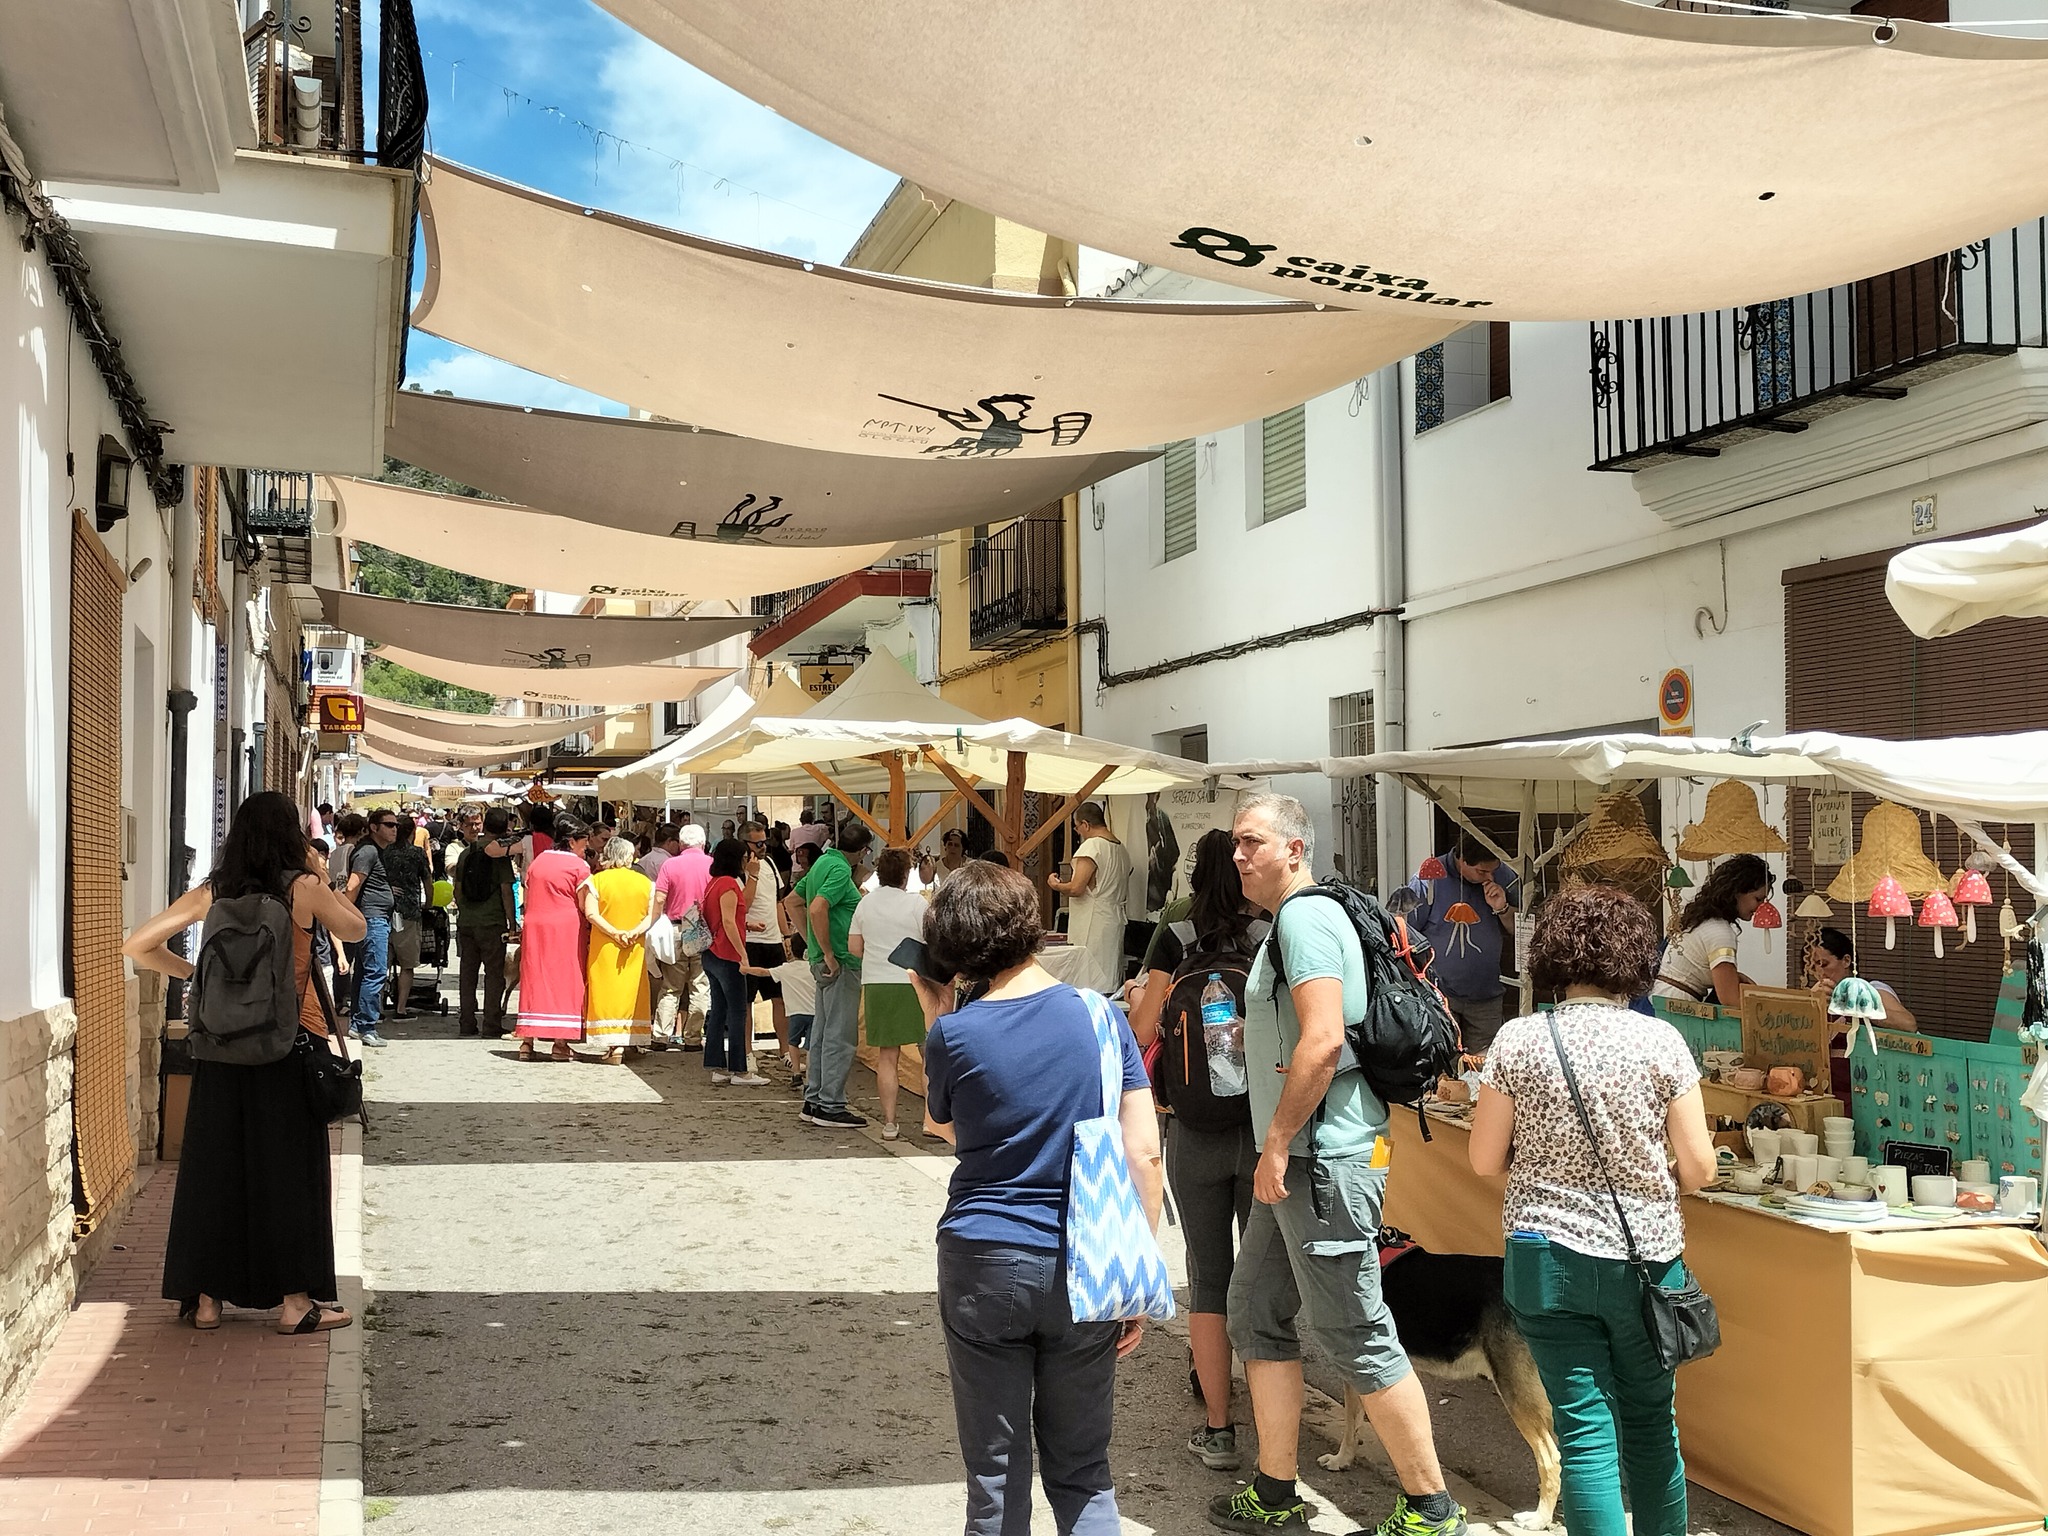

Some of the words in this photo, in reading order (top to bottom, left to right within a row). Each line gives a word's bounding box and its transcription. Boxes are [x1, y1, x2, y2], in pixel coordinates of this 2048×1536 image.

[1287, 256, 1429, 290] caixa
[1269, 266, 1494, 309] popular
[1915, 503, 1933, 526] 24
[323, 724, 363, 732] TABACOS
[1820, 814, 1828, 824] DE
[1831, 813, 1839, 824] LA
[1818, 826, 1842, 839] SUERTE
[1894, 1149, 1925, 1163] PIEZAS
